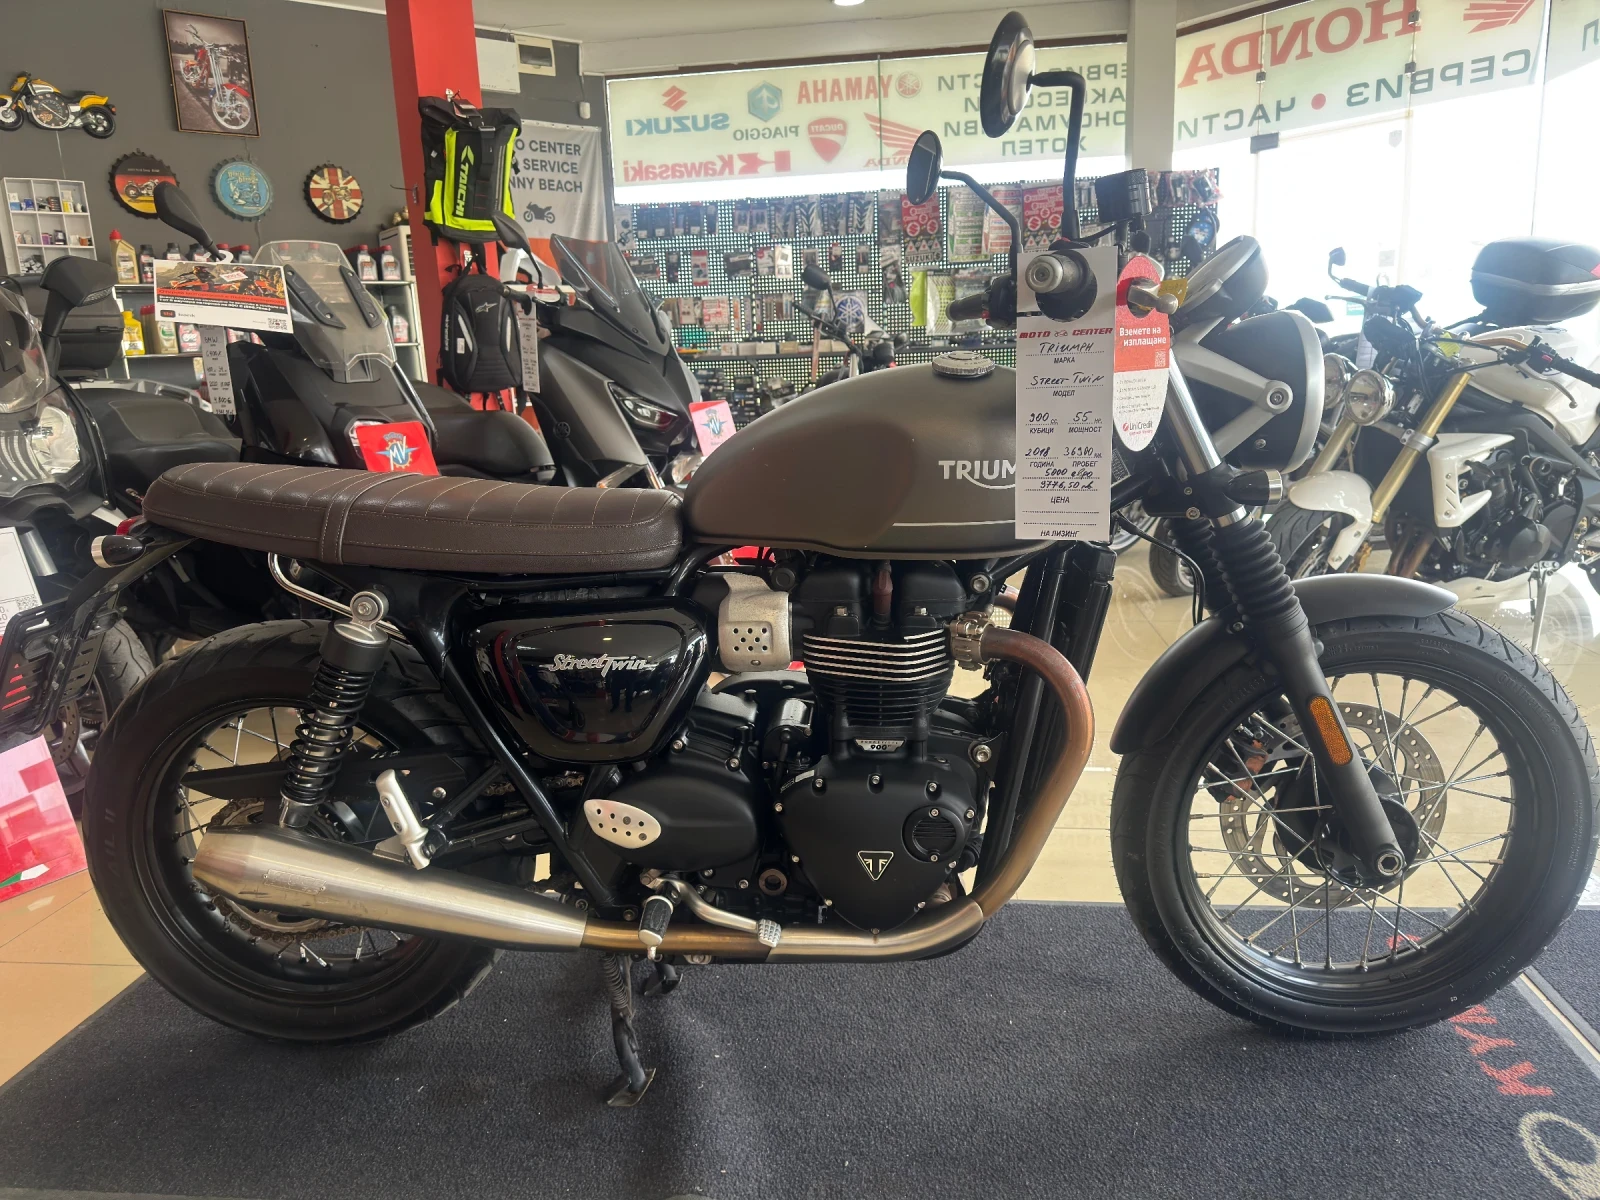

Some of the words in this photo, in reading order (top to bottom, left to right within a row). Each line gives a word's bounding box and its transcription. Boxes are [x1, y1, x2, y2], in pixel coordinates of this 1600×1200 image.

[529, 140, 581, 156] CENTER
[523, 158, 579, 174] SERVICE
[455, 163, 470, 217] TAICHI
[509, 176, 535, 189] NNY
[538, 178, 583, 193] BEACH
[905, 254, 933, 264] SUZUKI
[1019, 331, 1051, 339] MOTO
[1072, 327, 1113, 336] CENTER
[1119, 327, 1150, 336] Вземете
[1123, 336, 1167, 347] изплащане
[1053, 356, 1075, 364] МАРКА
[1052, 390, 1075, 398] МОДЕЛ
[1072, 411, 1093, 422] 55
[1029, 427, 1054, 435] КУБИЦИ
[1068, 426, 1102, 434] МОЩНОСТ
[1024, 446, 1051, 457] 2018
[938, 460, 1016, 487] TRIUM
[1050, 496, 1070, 504] ЦЕНА
